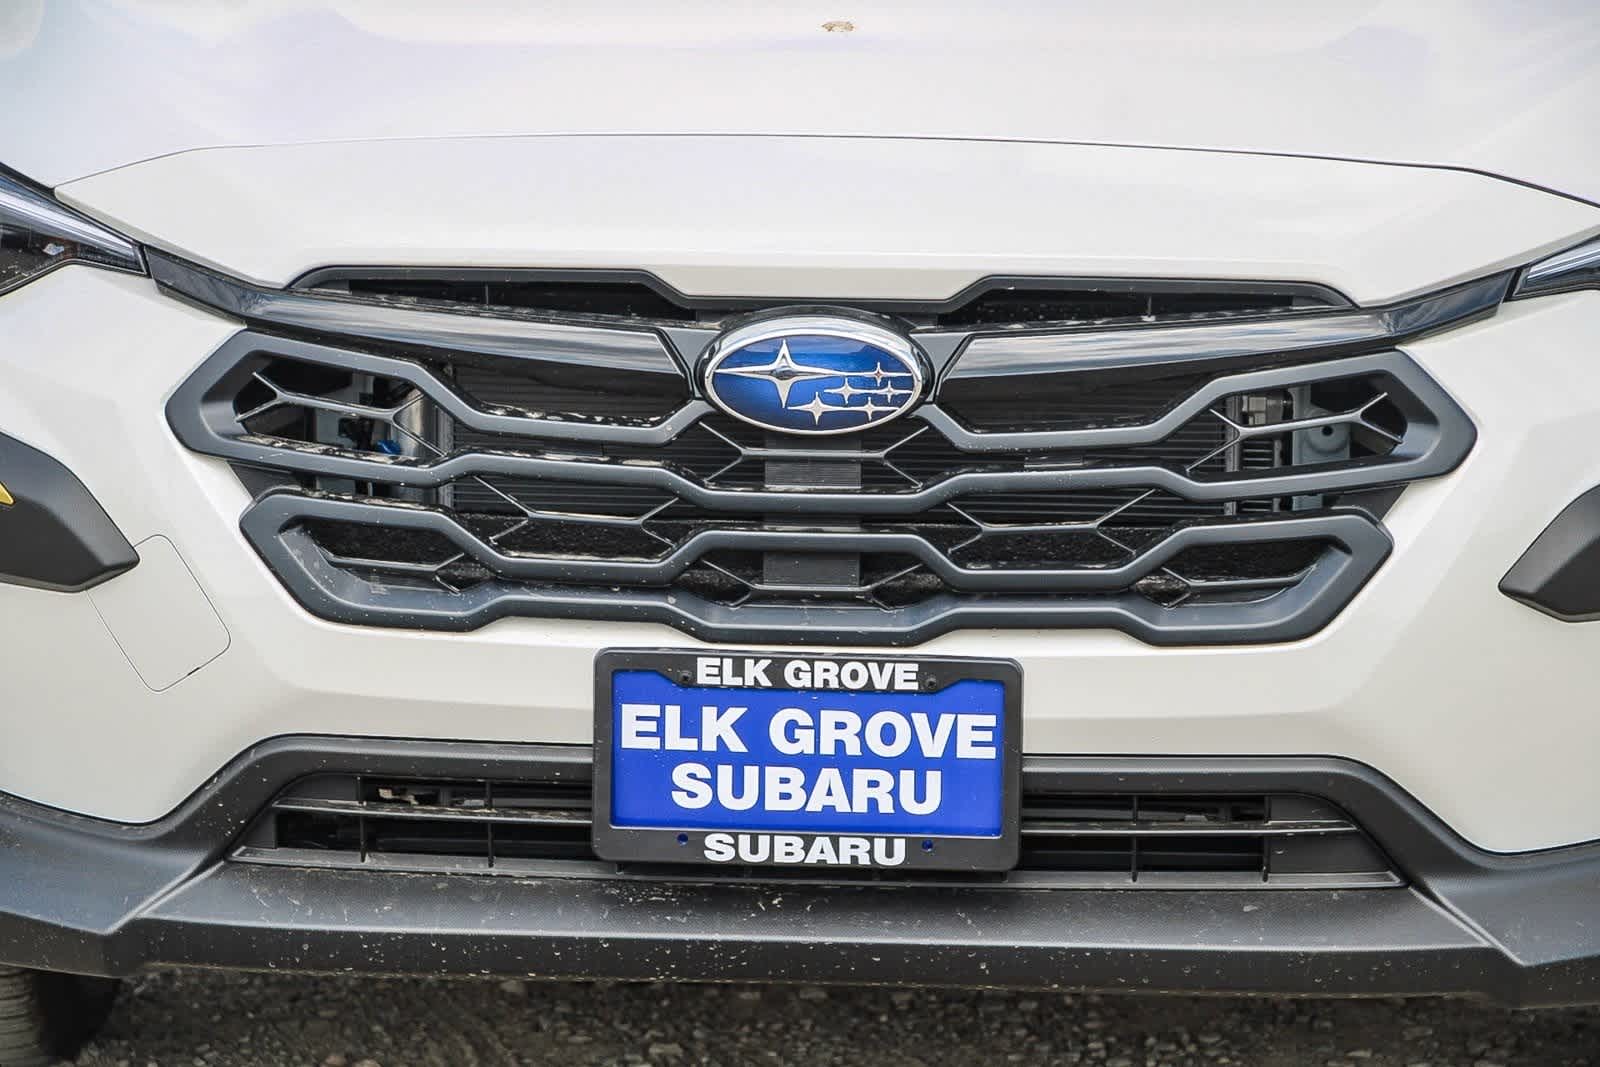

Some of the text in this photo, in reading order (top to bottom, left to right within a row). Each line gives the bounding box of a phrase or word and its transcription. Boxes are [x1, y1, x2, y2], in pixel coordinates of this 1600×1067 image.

[697, 657, 919, 690] ELK GROVE
[620, 703, 998, 760] ELK GROVE
[671, 762, 942, 815] SUBARU
[703, 833, 906, 866] SUBARU
